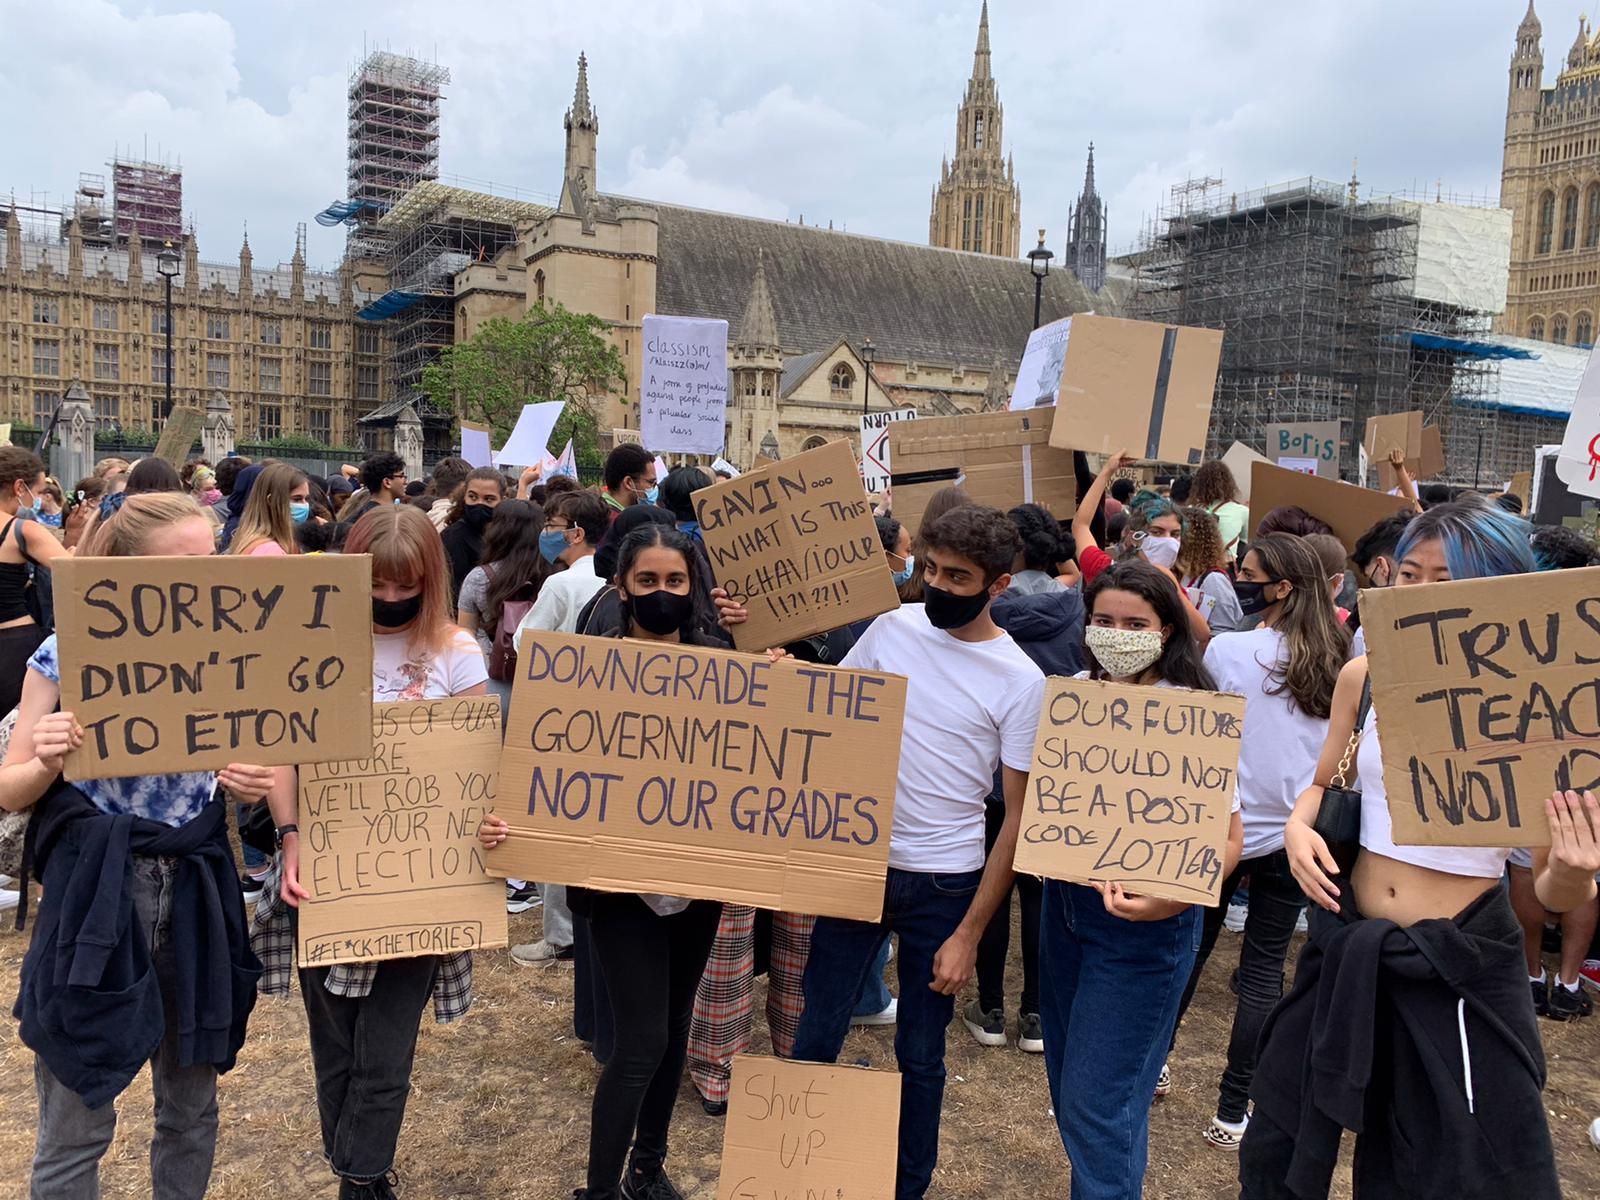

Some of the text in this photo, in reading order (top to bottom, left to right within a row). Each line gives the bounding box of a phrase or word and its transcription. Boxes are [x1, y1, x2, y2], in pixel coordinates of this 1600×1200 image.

[650, 375, 656, 385] A
[679, 394, 700, 406] people
[705, 398, 724, 410] from
[710, 519, 781, 568] WHAT
[790, 510, 818, 536] IS
[82, 579, 341, 640] SORRY I
[81, 651, 345, 702] DIDN'T GO
[528, 641, 886, 723] DOWNGRADE THE
[409, 703, 442, 735] OF
[451, 700, 499, 733] OUR
[1050, 691, 1133, 731] OUR
[84, 707, 319, 761] TO ETON
[531, 707, 833, 785] GOVERNMENT
[304, 781, 371, 817] WE'LL
[384, 774, 441, 810] ROB
[1036, 775, 1082, 815] BE
[1088, 784, 1117, 817] A
[1182, 755, 1232, 792] NOT
[1409, 755, 1522, 828] NOT
[527, 766, 879, 846] NOT OUR GRADES
[309, 819, 343, 853] OF
[363, 811, 431, 847] YOUR
[1024, 823, 1098, 846] CODE
[312, 847, 487, 897] ELECTION
[745, 1074, 829, 1121] Shut
[780, 1129, 826, 1169] UP
